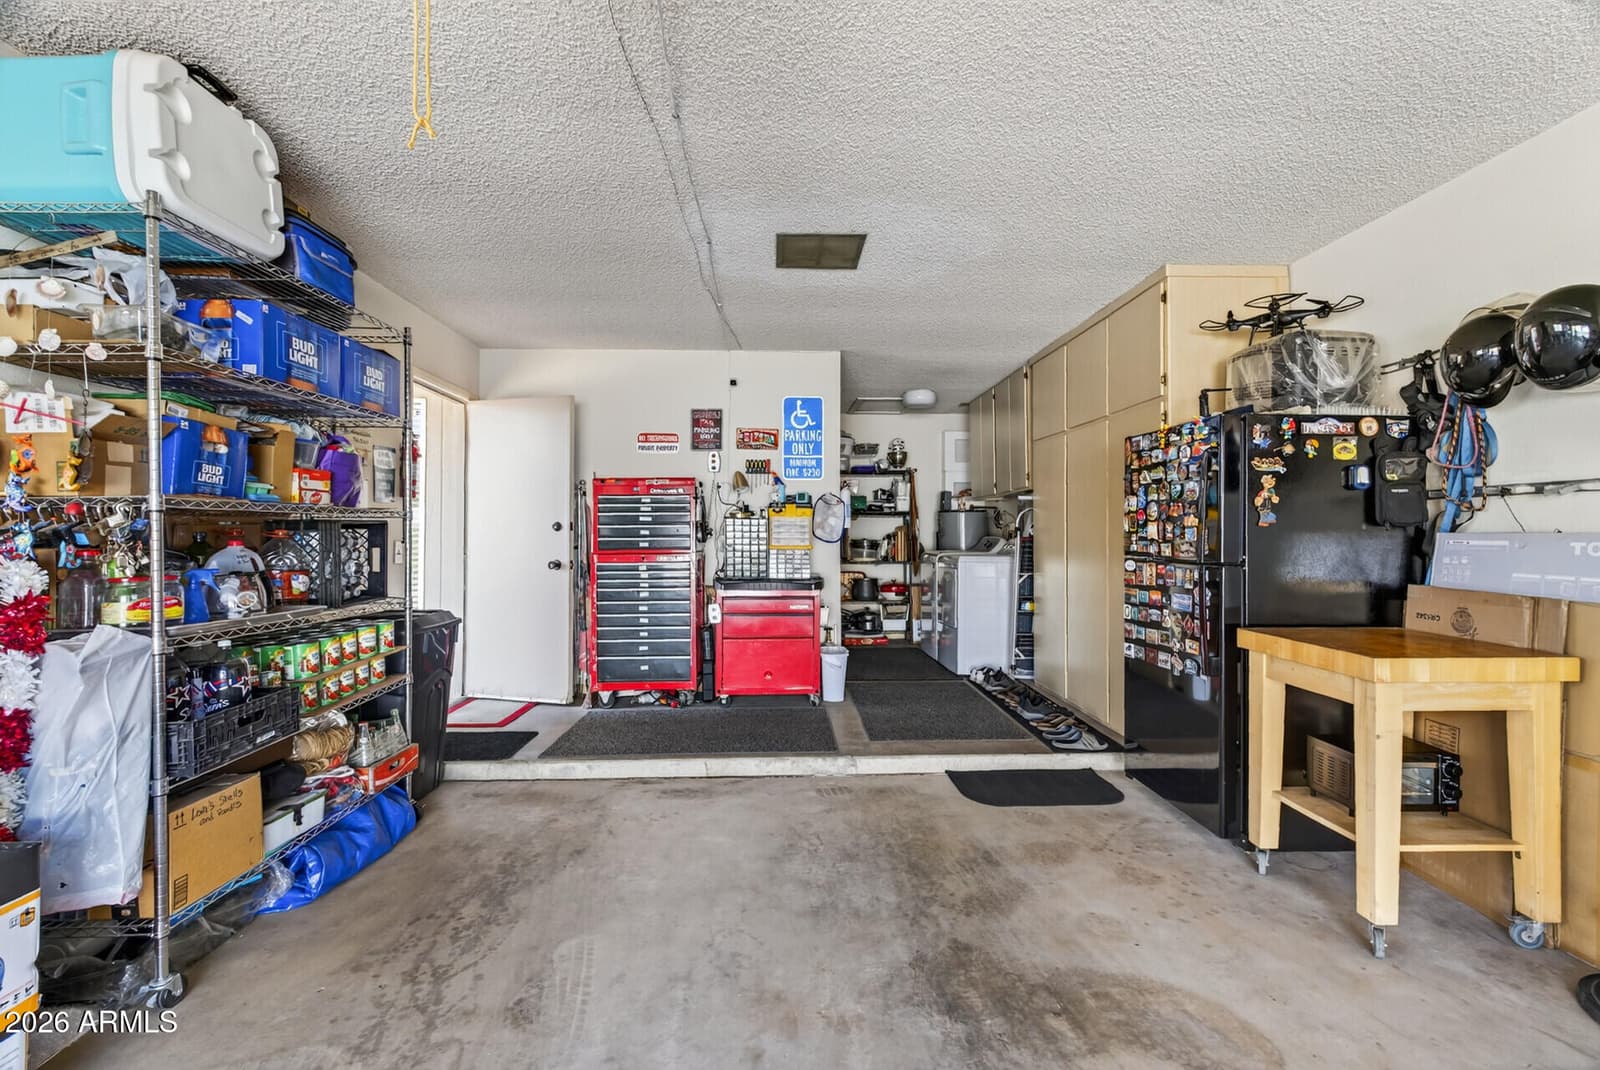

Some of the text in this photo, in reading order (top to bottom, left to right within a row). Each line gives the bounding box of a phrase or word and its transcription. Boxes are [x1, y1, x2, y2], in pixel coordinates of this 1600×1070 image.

[291, 336, 315, 355] BUD
[289, 348, 318, 370] LIGHT
[365, 365, 384, 381] BUD
[363, 375, 385, 393] LIGHT
[784, 429, 822, 441] PARKING
[792, 442, 815, 455] ONLY
[202, 463, 223, 475] BUD
[790, 459, 817, 467] MINIMUM
[197, 471, 225, 485] LIGHT
[785, 467, 800, 477] FINE
